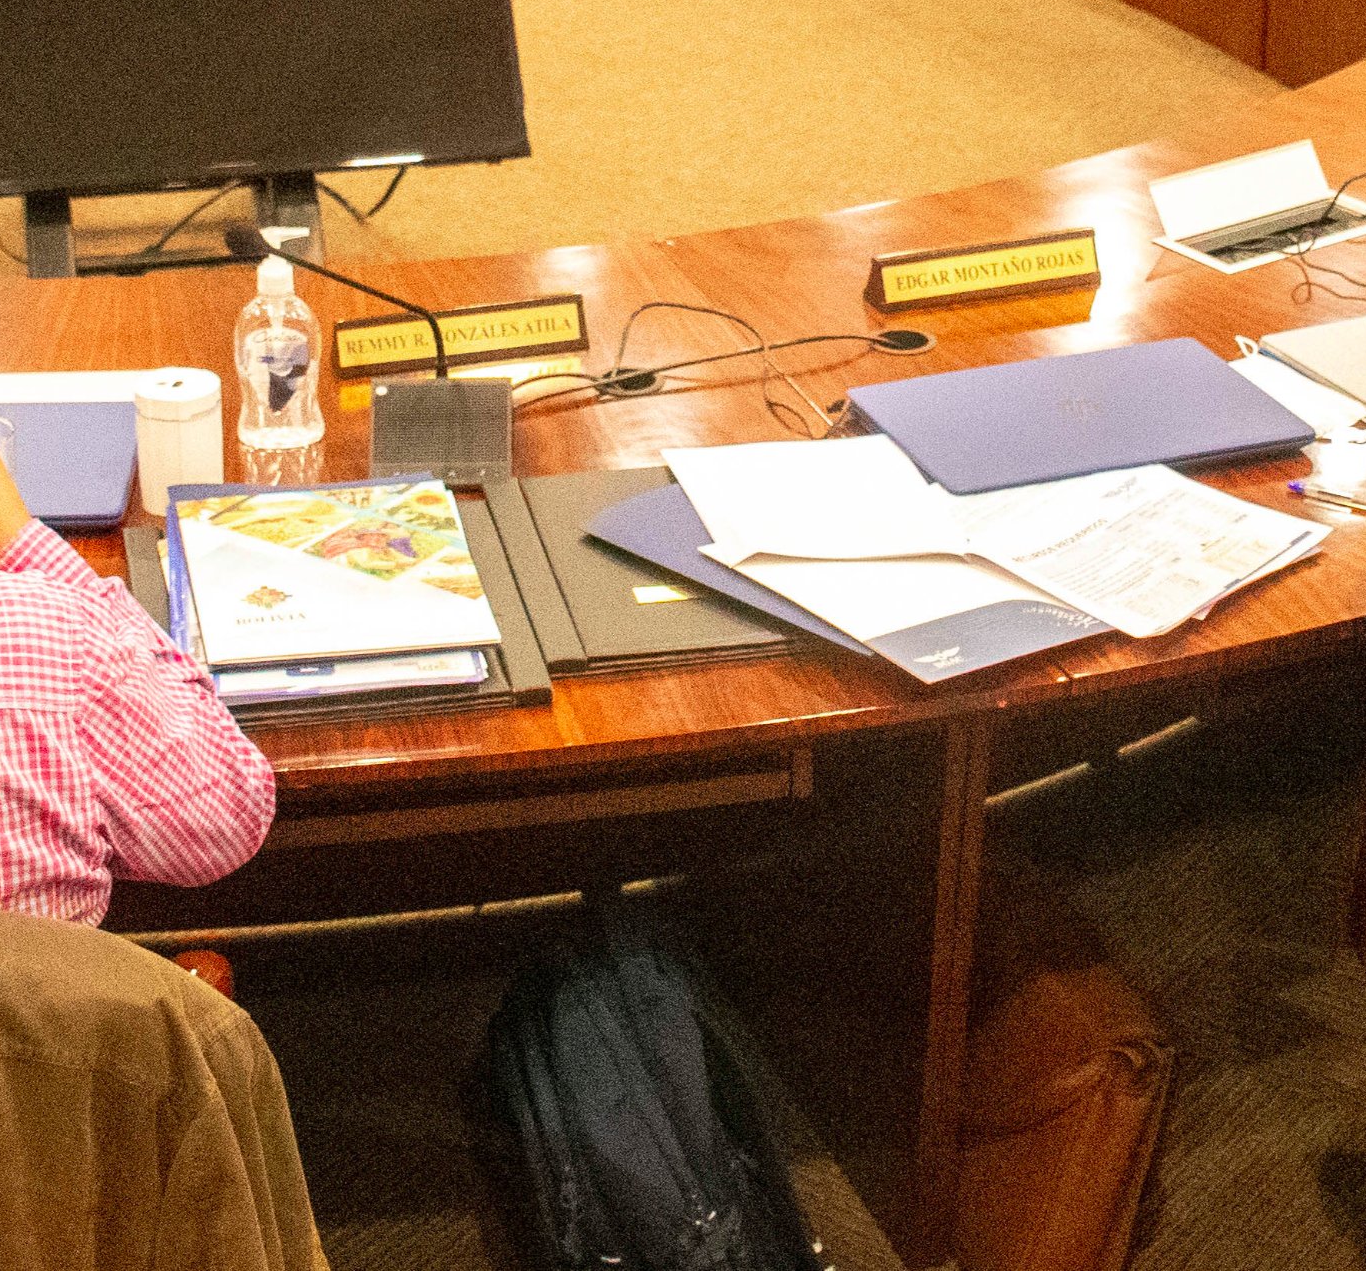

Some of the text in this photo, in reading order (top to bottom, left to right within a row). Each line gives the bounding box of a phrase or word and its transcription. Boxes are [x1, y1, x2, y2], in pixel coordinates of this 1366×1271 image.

[895, 250, 1085, 291] EDGAR MONTAÑO ROJAS
[345, 317, 572, 356] REMMY R. ONZÁLES ATILA
